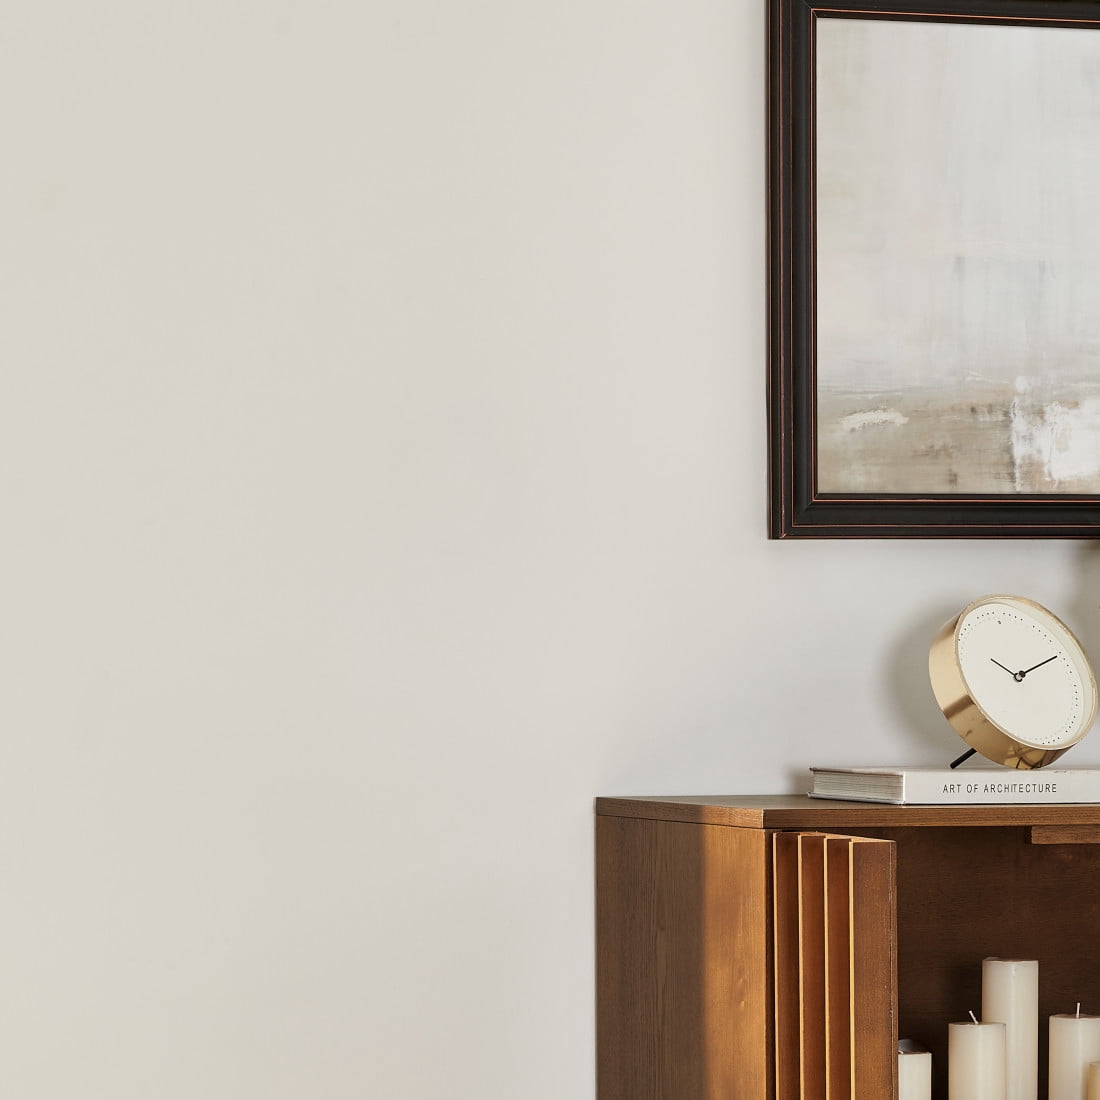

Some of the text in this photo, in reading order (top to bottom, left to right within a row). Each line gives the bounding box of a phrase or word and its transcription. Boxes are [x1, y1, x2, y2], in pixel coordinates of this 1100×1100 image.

[942, 783, 1057, 794] ART OF ARCHITECTURE
